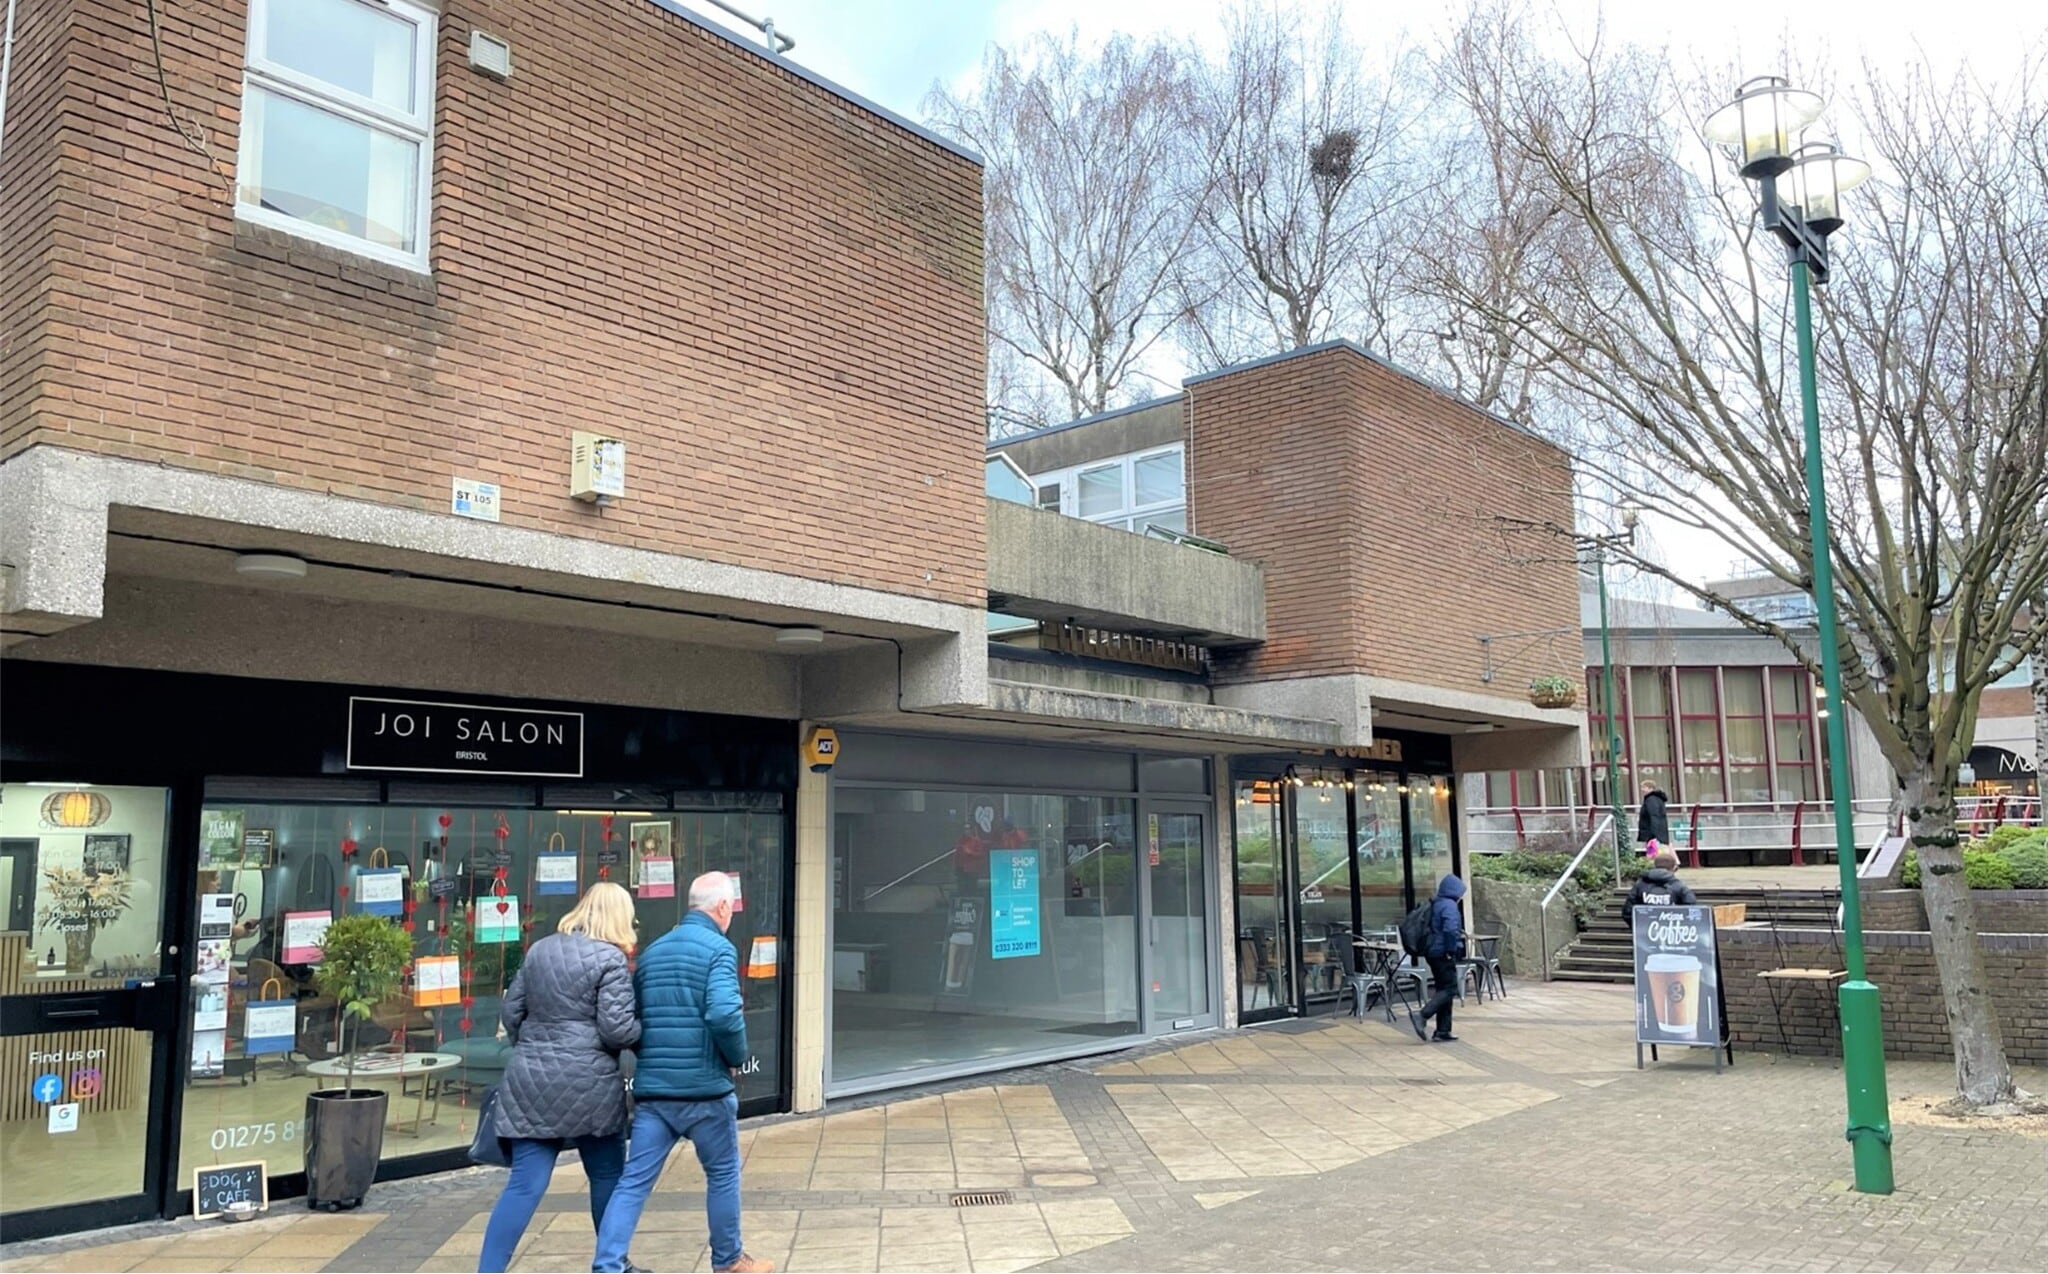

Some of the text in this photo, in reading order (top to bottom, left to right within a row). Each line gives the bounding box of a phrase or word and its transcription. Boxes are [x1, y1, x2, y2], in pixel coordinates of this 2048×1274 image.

[456, 490, 492, 505] ST 105
[374, 712, 563, 745] JOI SALON
[818, 740, 833, 752] ADT
[455, 750, 488, 761] BRISTOL
[1011, 856, 1036, 867] SHOP
[1012, 867, 1025, 878] TO
[1012, 878, 1026, 889] LET
[1647, 920, 1699, 945] Coffee
[90, 959, 159, 979] davines
[29, 1049, 106, 1065] Find us on
[211, 1122, 276, 1151] 01275
[208, 1172, 241, 1190] DOG
